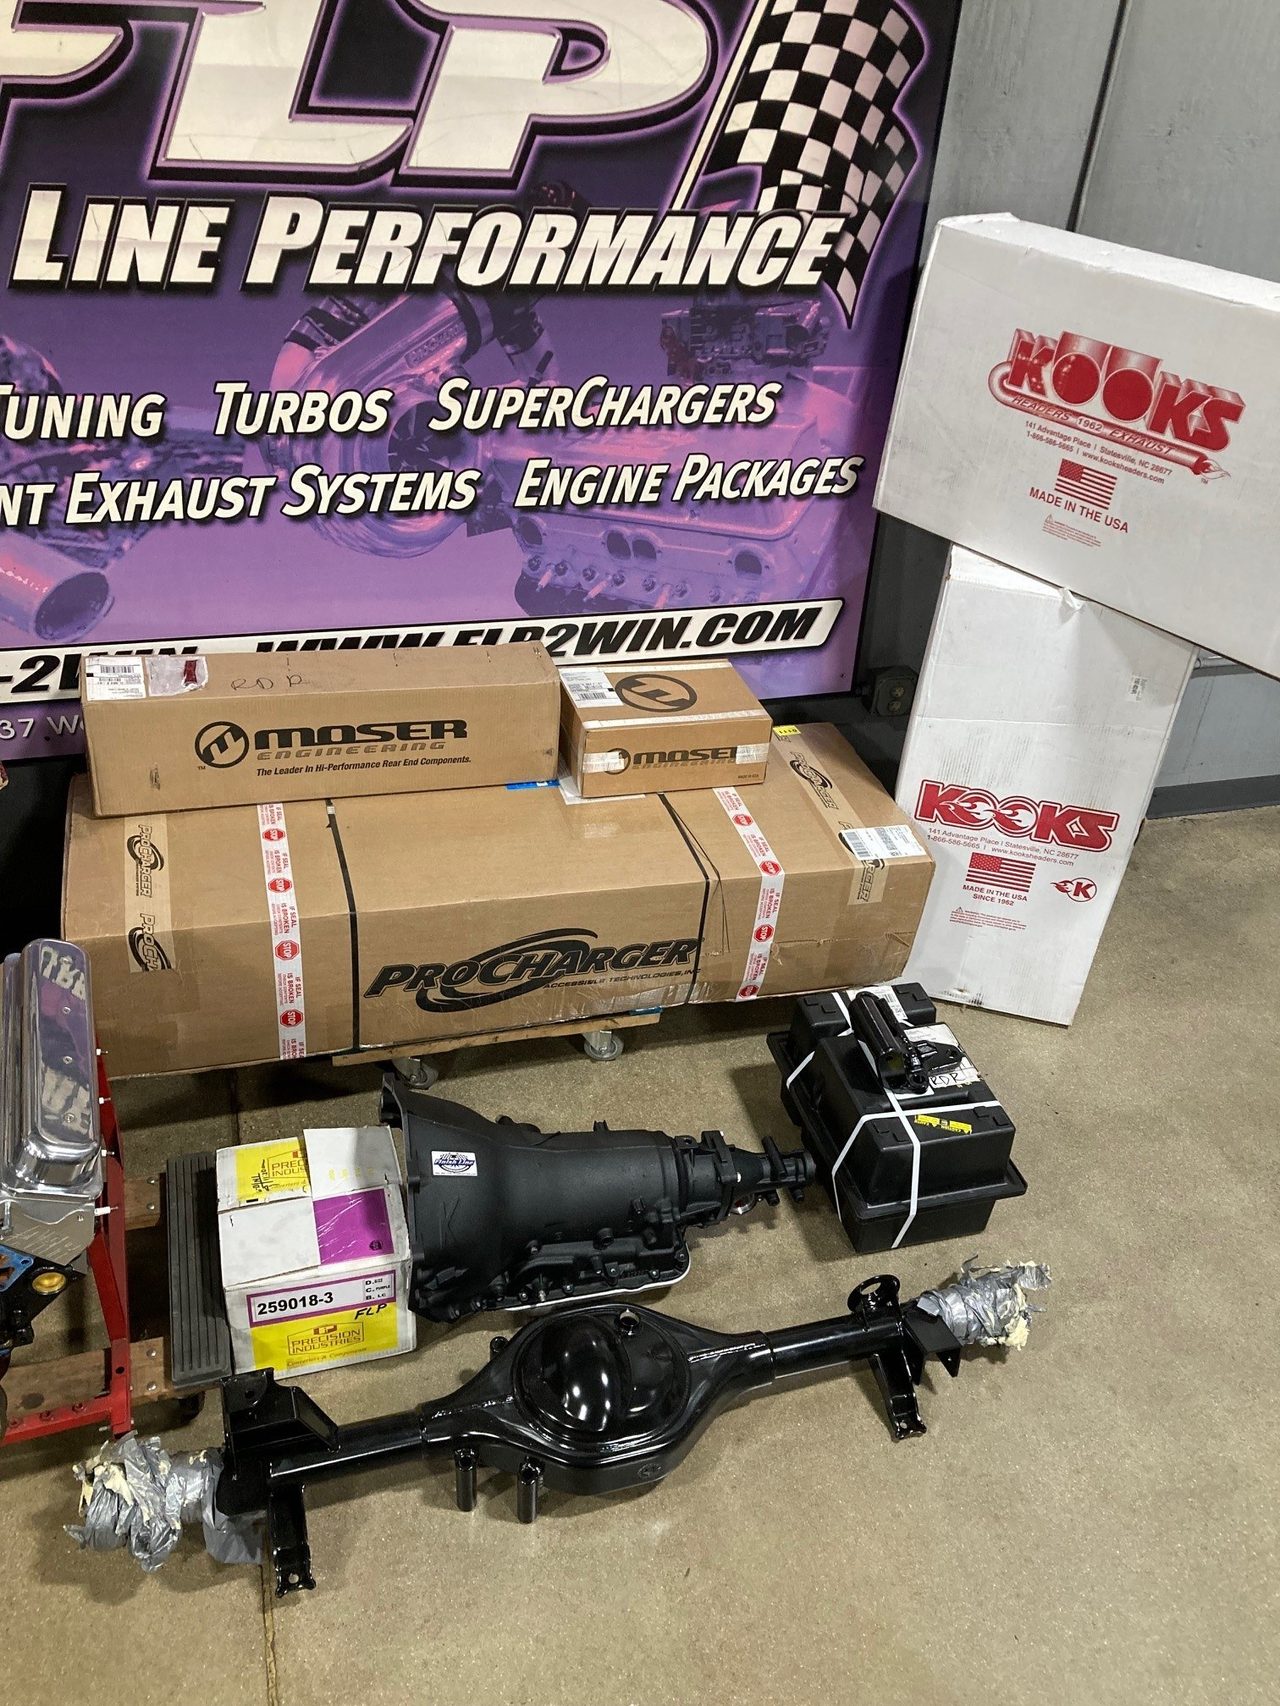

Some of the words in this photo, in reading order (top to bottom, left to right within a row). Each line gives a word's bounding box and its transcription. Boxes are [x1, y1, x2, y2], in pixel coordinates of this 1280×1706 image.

[11, 183, 230, 286] LINE
[246, 191, 849, 287] PERFORMANCE
[1008, 328, 1246, 451] KOOKS
[0, 384, 166, 440] UNING
[214, 381, 393, 436] TURBOS
[1012, 395, 1073, 421] HEADERS
[1078, 417, 1103, 432] 1962
[1109, 428, 1176, 455] EXHAUST
[1025, 420, 1037, 430] 141
[1037, 425, 1073, 442] Advantage
[1073, 436, 1092, 448] Place
[1099, 446, 1137, 465] Statesville,
[1138, 459, 1150, 469] NC
[1151, 464, 1173, 476] 28677
[514, 458, 671, 508] ENGINE
[673, 452, 866, 502] PACKAGES
[1082, 450, 1165, 484] www.kooksheaders.com
[66, 471, 277, 525] EXHAUST
[281, 462, 483, 517] SYSTEMS
[1029, 486, 1062, 507] MADE
[1063, 499, 1077, 513] IN
[1079, 505, 1103, 523] THE
[1104, 514, 1129, 533] USA
[254, 719, 468, 750] MOSER
[256, 768, 272, 777] The
[274, 766, 303, 775] Leader
[305, 765, 313, 773] In
[315, 760, 380, 772] Hi-Performance
[382, 759, 402, 768] Rear
[403, 758, 419, 767] End
[420, 755, 471, 767] Components.
[257, 741, 446, 761] ENGINEERING
[914, 779, 1120, 852] KOOKS
[928, 827, 941, 835] 141
[941, 830, 979, 842] Advantage
[980, 836, 1000, 846] Place
[1004, 841, 1042, 854] Statesville,
[1043, 848, 1056, 856] NC
[1056, 850, 1079, 860] 28677
[991, 847, 1075, 867] www.kooksheaders.com
[962, 884, 985, 894] MADE
[995, 890, 1011, 898] THE
[1011, 893, 1028, 902] USA
[972, 893, 996, 903] SINCE
[997, 898, 1015, 906] 1962
[760, 926, 769, 940] STOP
[283, 942, 292, 958] STOP
[364, 937, 703, 998] PROCHARGER
[287, 1011, 296, 1025] STOP
[257, 1291, 334, 1316] 259018-3
[354, 1303, 388, 1320] FLP
[291, 1328, 361, 1347] PRECISION
[292, 1336, 362, 1354] INDUSTRIES
